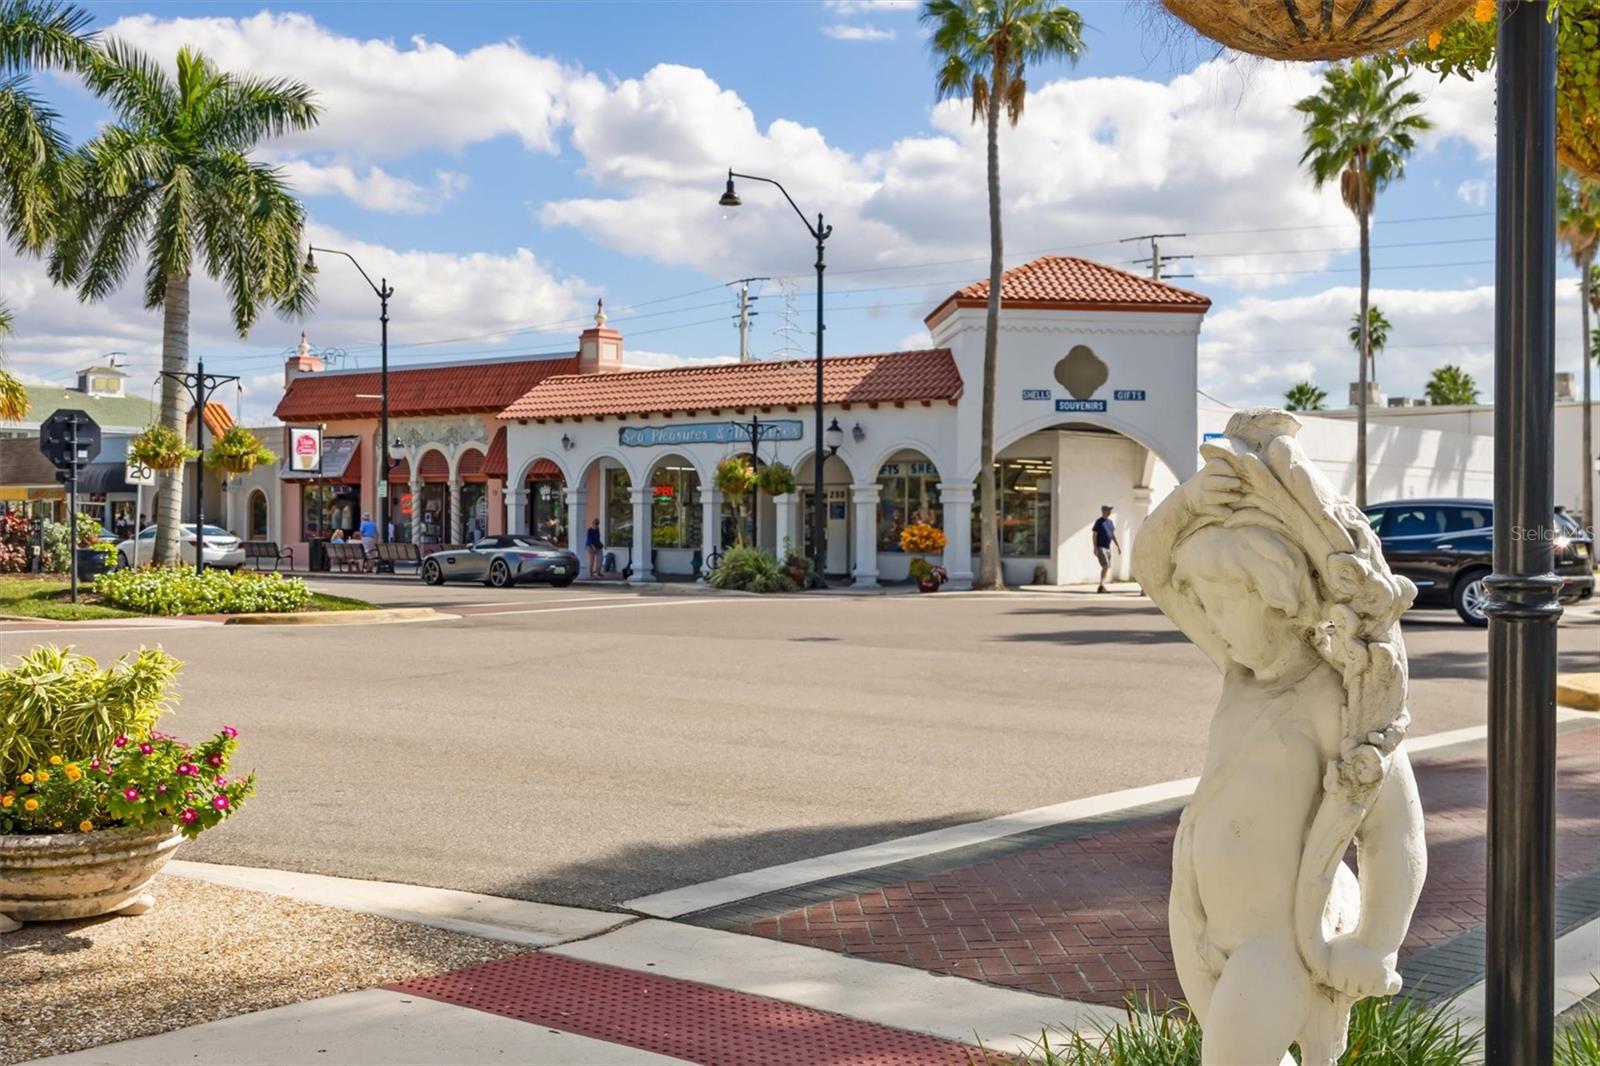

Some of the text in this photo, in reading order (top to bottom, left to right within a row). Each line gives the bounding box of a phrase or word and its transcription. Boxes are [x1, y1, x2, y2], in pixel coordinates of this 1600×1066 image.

[1023, 390, 1051, 400] SHELLS
[1117, 391, 1143, 400] GIFTS
[1059, 401, 1104, 411] SOUVENIRS
[623, 430, 643, 443] Sea
[651, 428, 708, 442] Pleasures
[716, 426, 725, 440] &
[131, 465, 152, 480] 20
